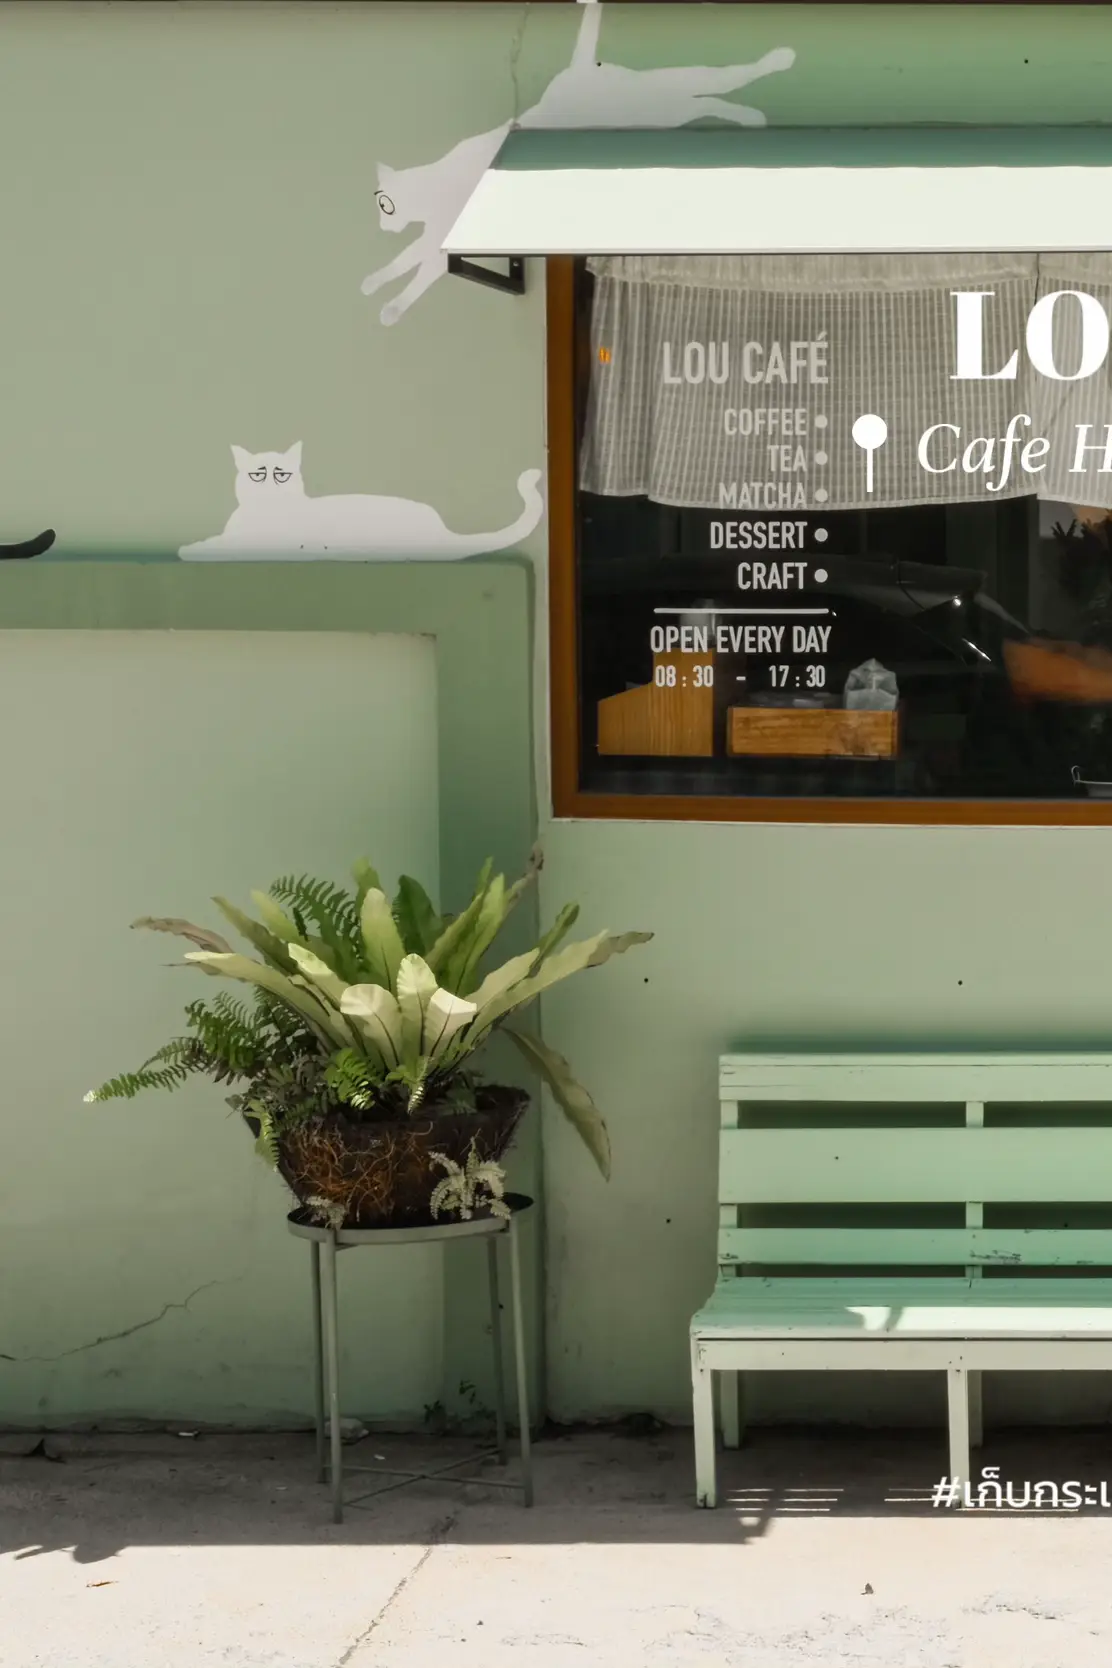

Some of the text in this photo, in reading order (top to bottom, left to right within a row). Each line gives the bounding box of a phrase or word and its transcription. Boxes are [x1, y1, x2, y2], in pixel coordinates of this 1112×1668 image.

[662, 330, 829, 385] LOU CAFÉ
[723, 407, 808, 436] COFFEE
[767, 444, 808, 472] TEA
[718, 481, 808, 511] MATCHA
[709, 521, 808, 549] DESSERT
[737, 562, 808, 590] CRAFT
[650, 625, 832, 653] OPEN EVERY DAY
